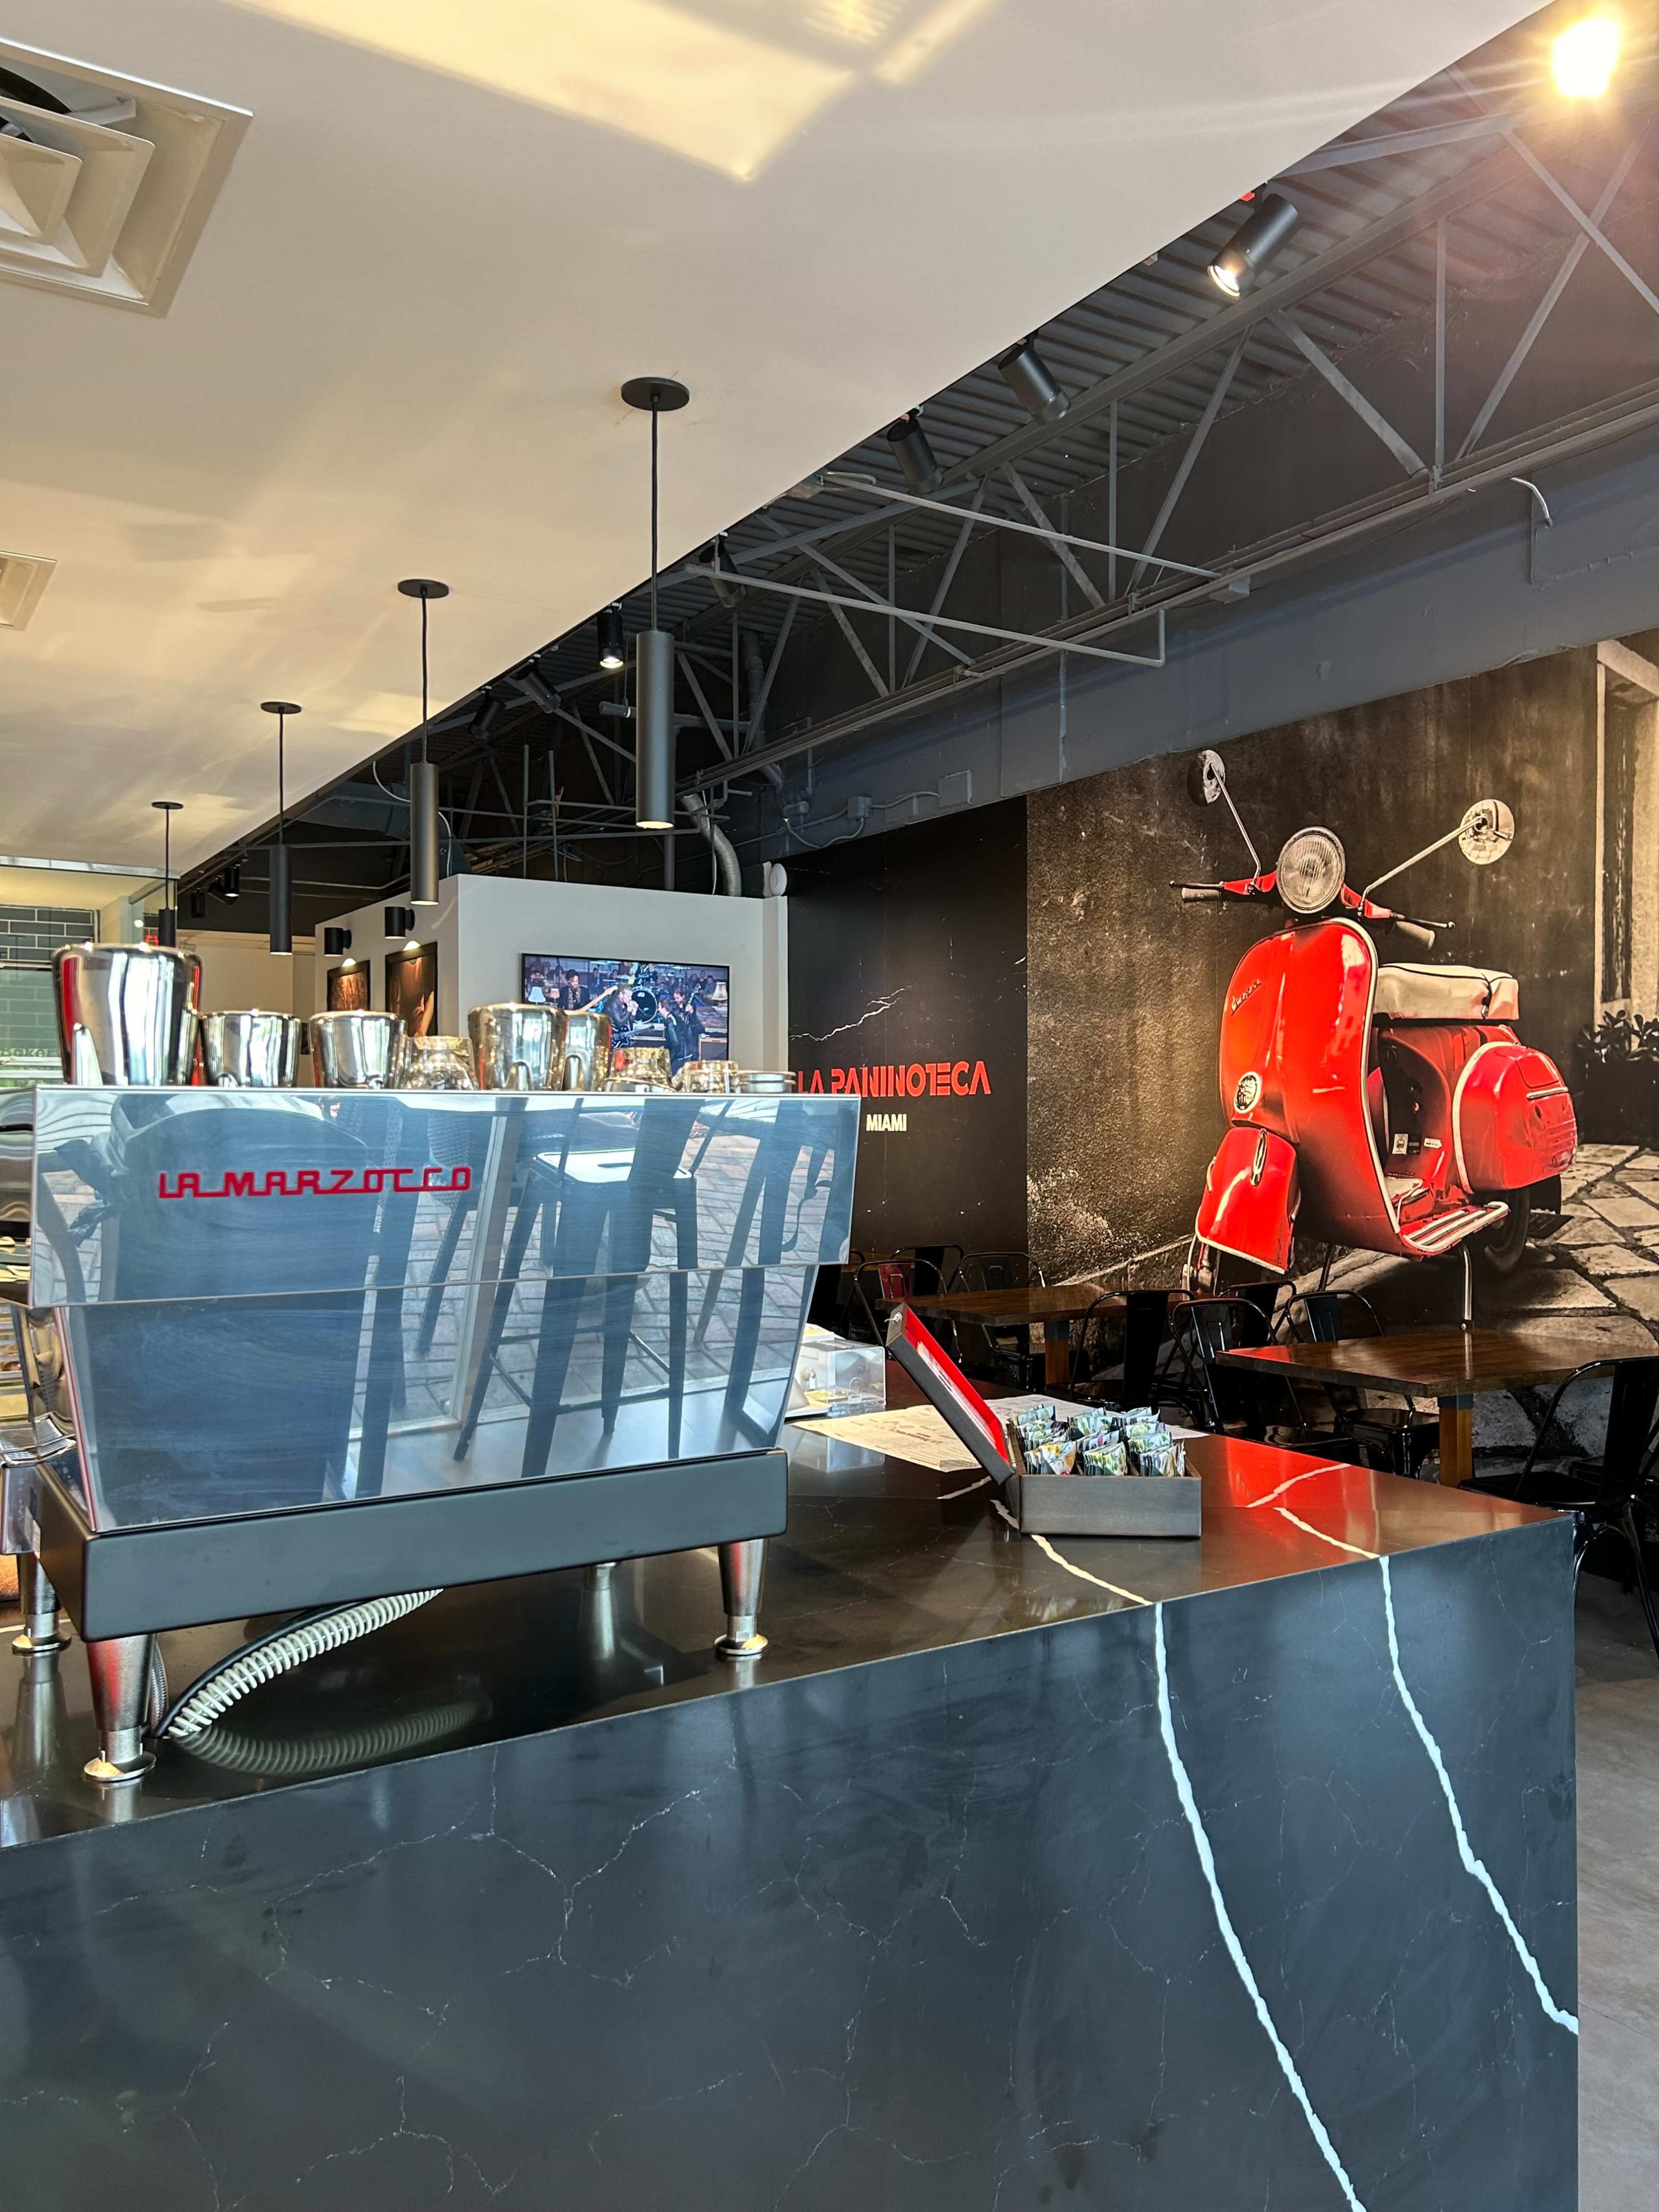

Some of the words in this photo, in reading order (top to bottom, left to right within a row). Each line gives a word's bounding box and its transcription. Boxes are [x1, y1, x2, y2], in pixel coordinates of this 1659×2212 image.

[798, 1070, 824, 1093] LA
[831, 1061, 992, 1098] PANINOTECA
[866, 1113, 907, 1132] MIAMI
[159, 1170, 200, 1198] LA
